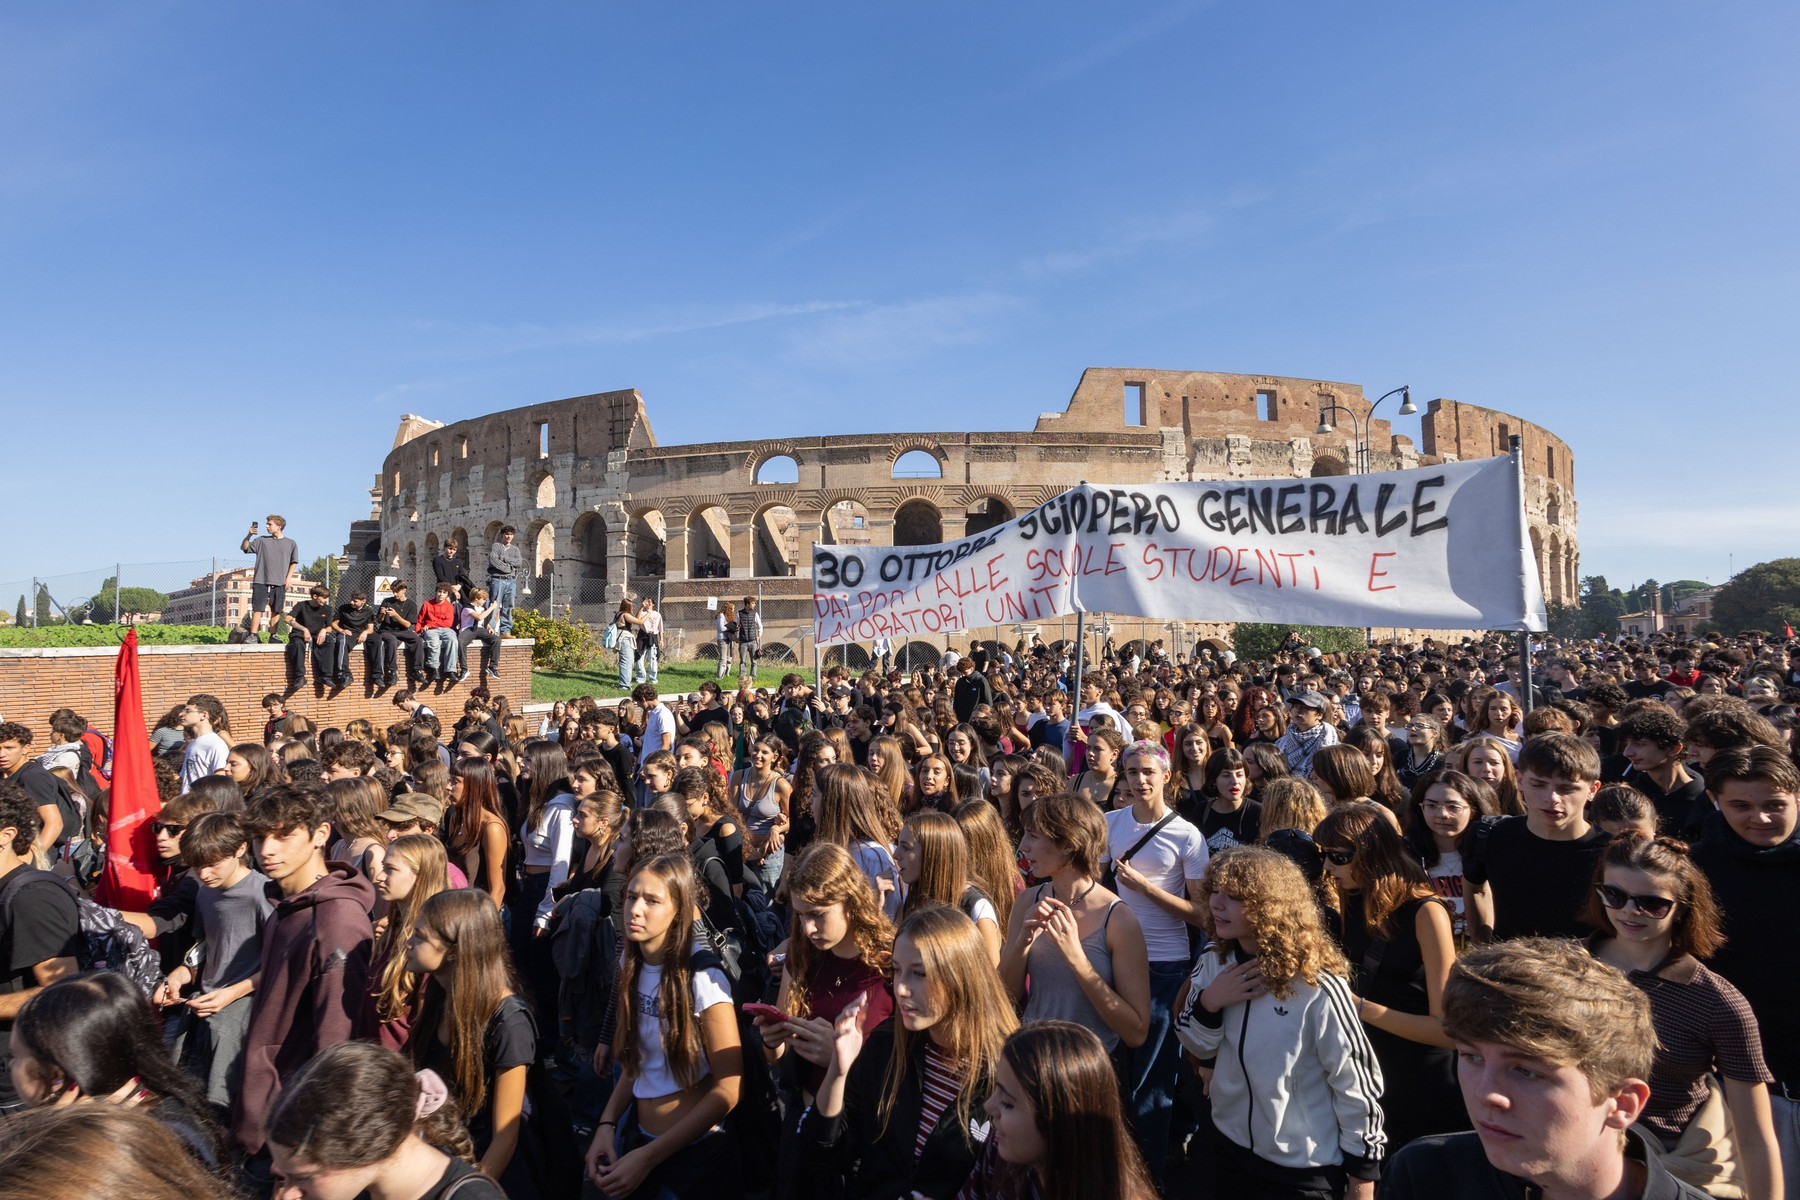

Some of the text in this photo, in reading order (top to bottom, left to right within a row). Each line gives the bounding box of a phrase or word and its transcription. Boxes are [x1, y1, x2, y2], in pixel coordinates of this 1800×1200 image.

[814, 551, 865, 590] 30
[1197, 475, 1449, 537] GENERALE
[935, 553, 1009, 599] ALLE
[1368, 552, 1397, 592] E
